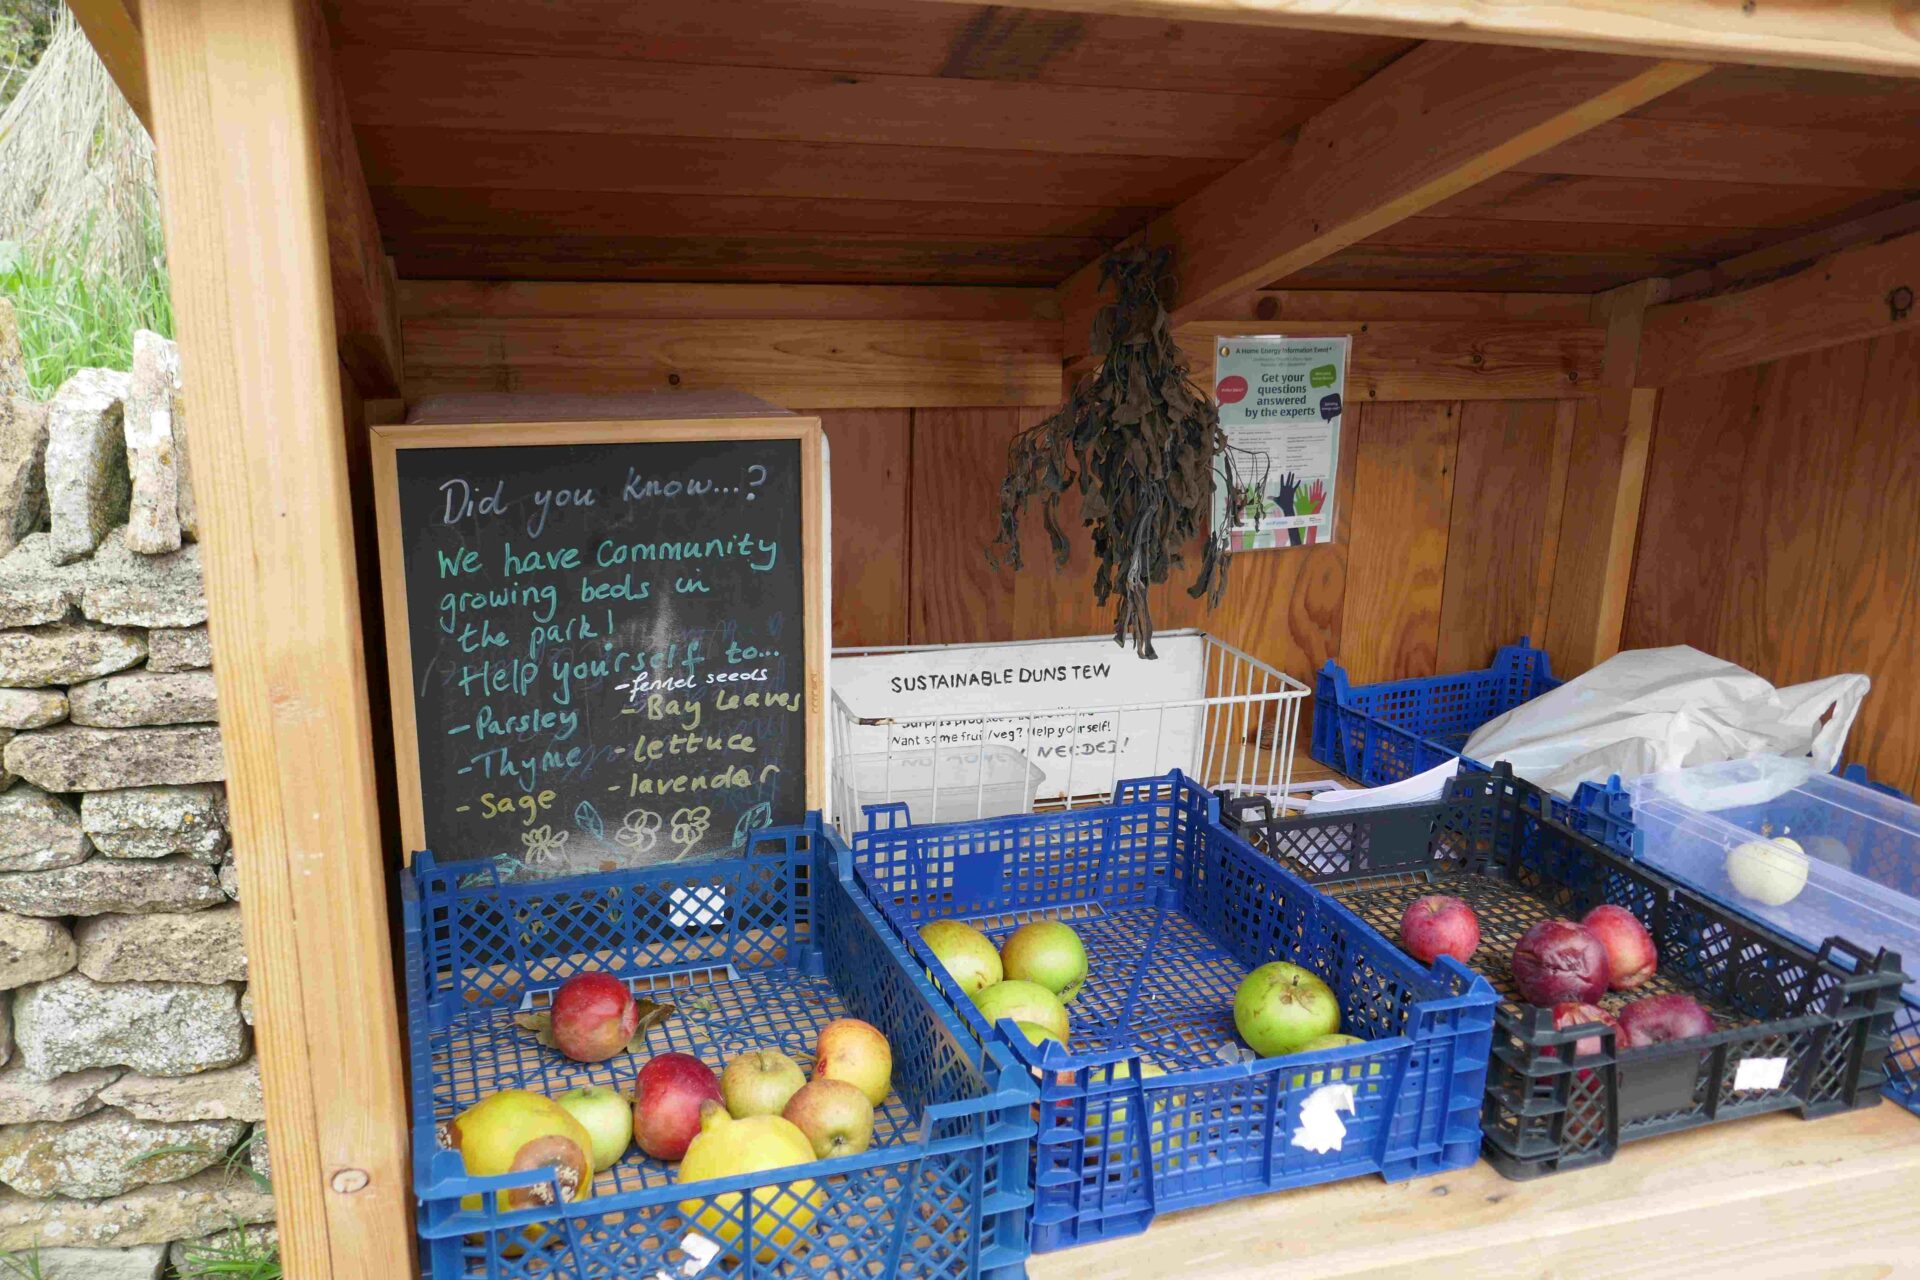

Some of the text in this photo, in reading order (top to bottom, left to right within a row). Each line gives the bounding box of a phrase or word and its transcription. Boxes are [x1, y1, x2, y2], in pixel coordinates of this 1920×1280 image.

[1241, 346, 1259, 354] Home
[1257, 384, 1307, 396] questions
[1261, 373, 1280, 383] Get
[1281, 373, 1305, 385] your
[1245, 407, 1316, 419] by the experts
[1256, 395, 1307, 406] answered
[439, 478, 508, 524] Did
[527, 488, 596, 538] you
[438, 547, 482, 578] We
[504, 542, 581, 577] have
[438, 567, 710, 634] growing beds in
[457, 619, 509, 653] the
[458, 658, 540, 697] Help
[552, 640, 705, 705] yourself
[706, 668, 768, 685] seeds
[890, 668, 1014, 694] SUSTAINABLE
[647, 693, 701, 731] Bay
[480, 789, 557, 826] Sage
